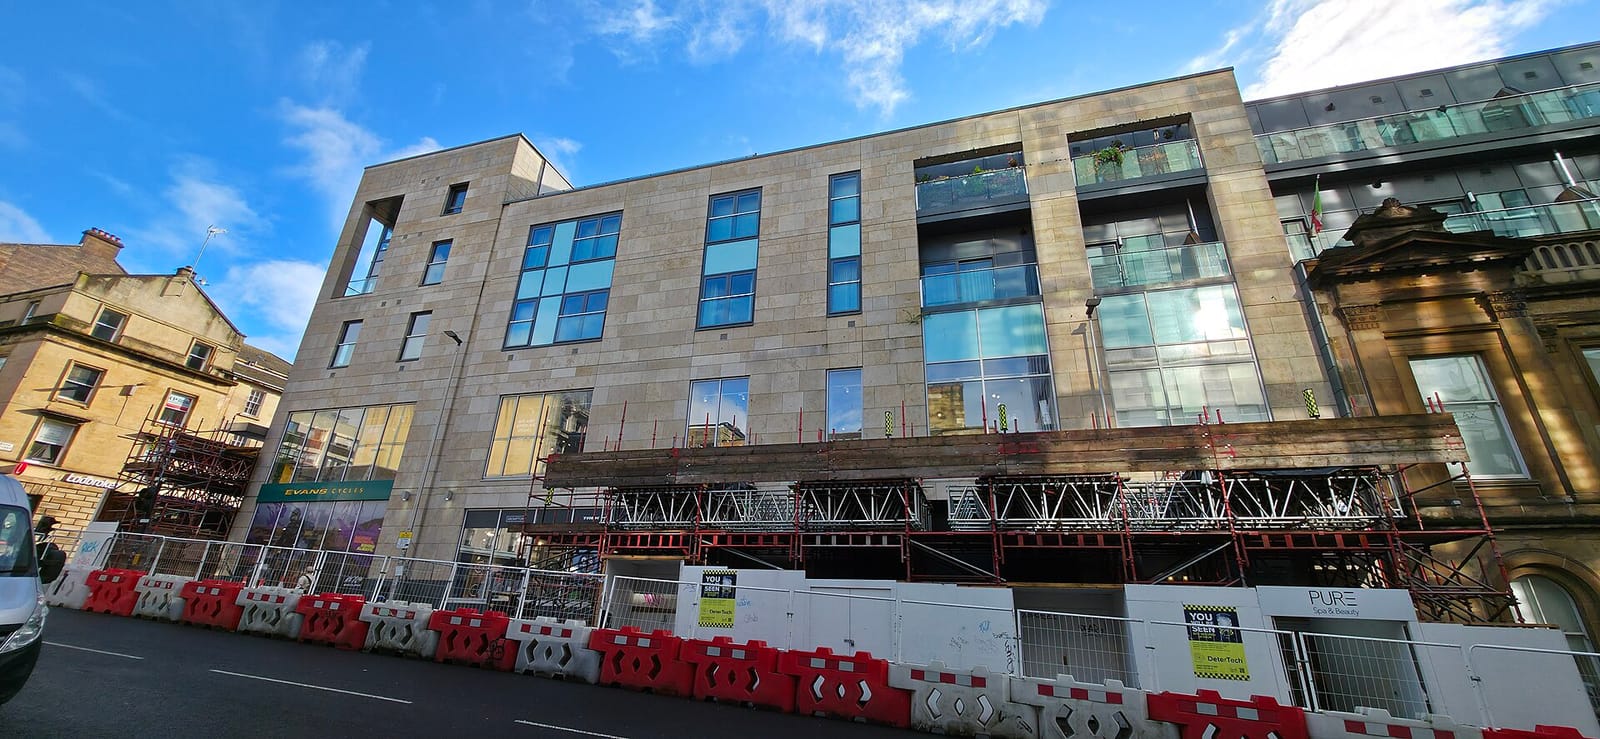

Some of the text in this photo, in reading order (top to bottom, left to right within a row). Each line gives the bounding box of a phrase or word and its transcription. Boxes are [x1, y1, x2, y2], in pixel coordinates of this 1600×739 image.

[285, 488, 328, 496] EVANS
[1308, 590, 1358, 606] PURE
[1189, 612, 1213, 621] YOU
[1313, 607, 1327, 616] Spa
[1335, 608, 1360, 617] Beauty
[1191, 625, 1216, 634] SEEN
[1207, 656, 1243, 664] DeterTech
